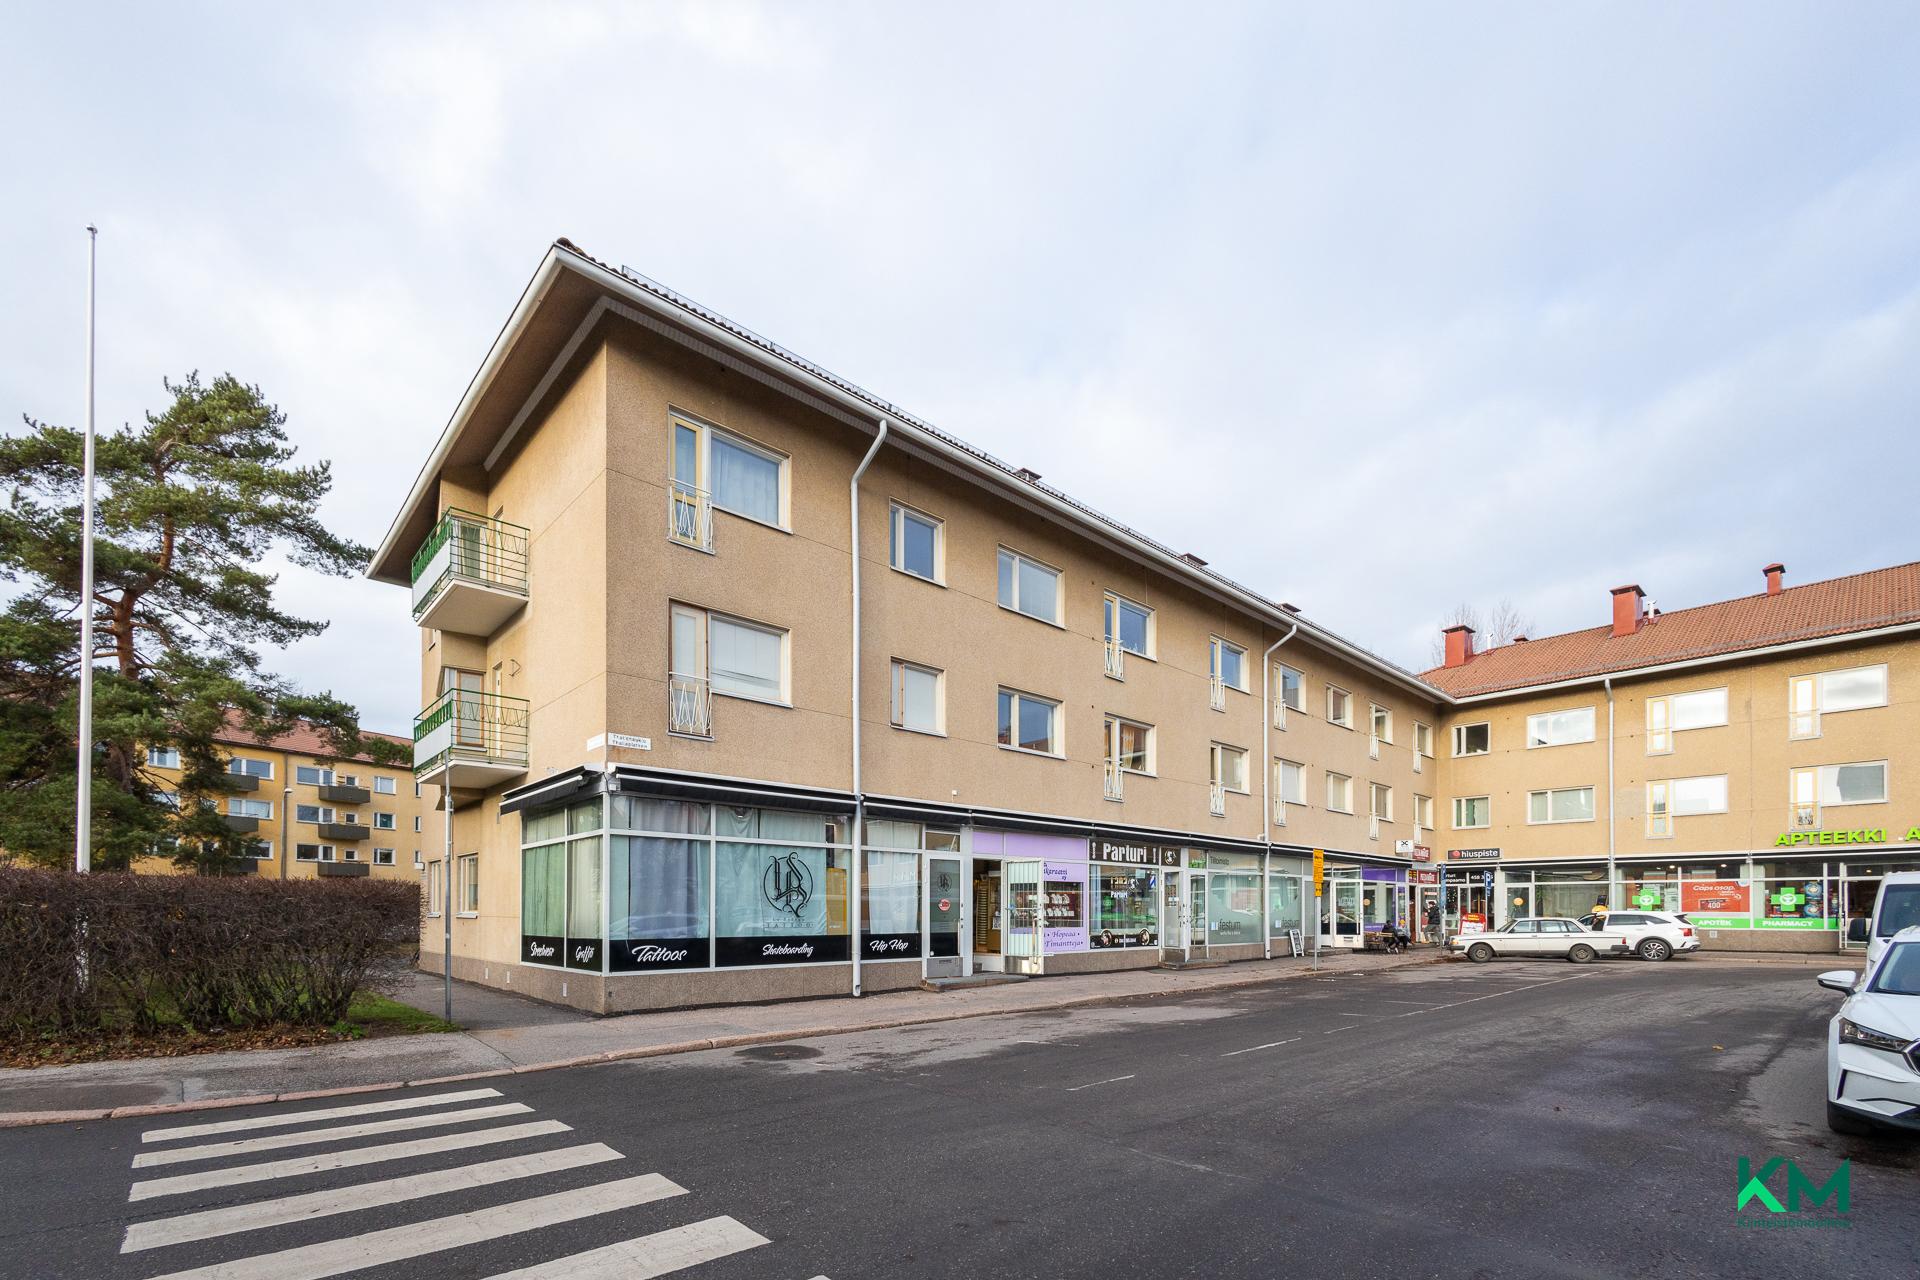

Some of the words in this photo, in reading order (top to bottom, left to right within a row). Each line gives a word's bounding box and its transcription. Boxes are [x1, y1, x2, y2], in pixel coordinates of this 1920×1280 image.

[1774, 828, 1887, 846] APTEEKKI
[1102, 842, 1148, 863] Parturi
[1461, 849, 1499, 859] hiuspiste
[631, 945, 688, 963] Tattoos
[762, 942, 814, 958] Skateboarding
[869, 940, 888, 953] Hip
[888, 938, 909, 951] Hop
